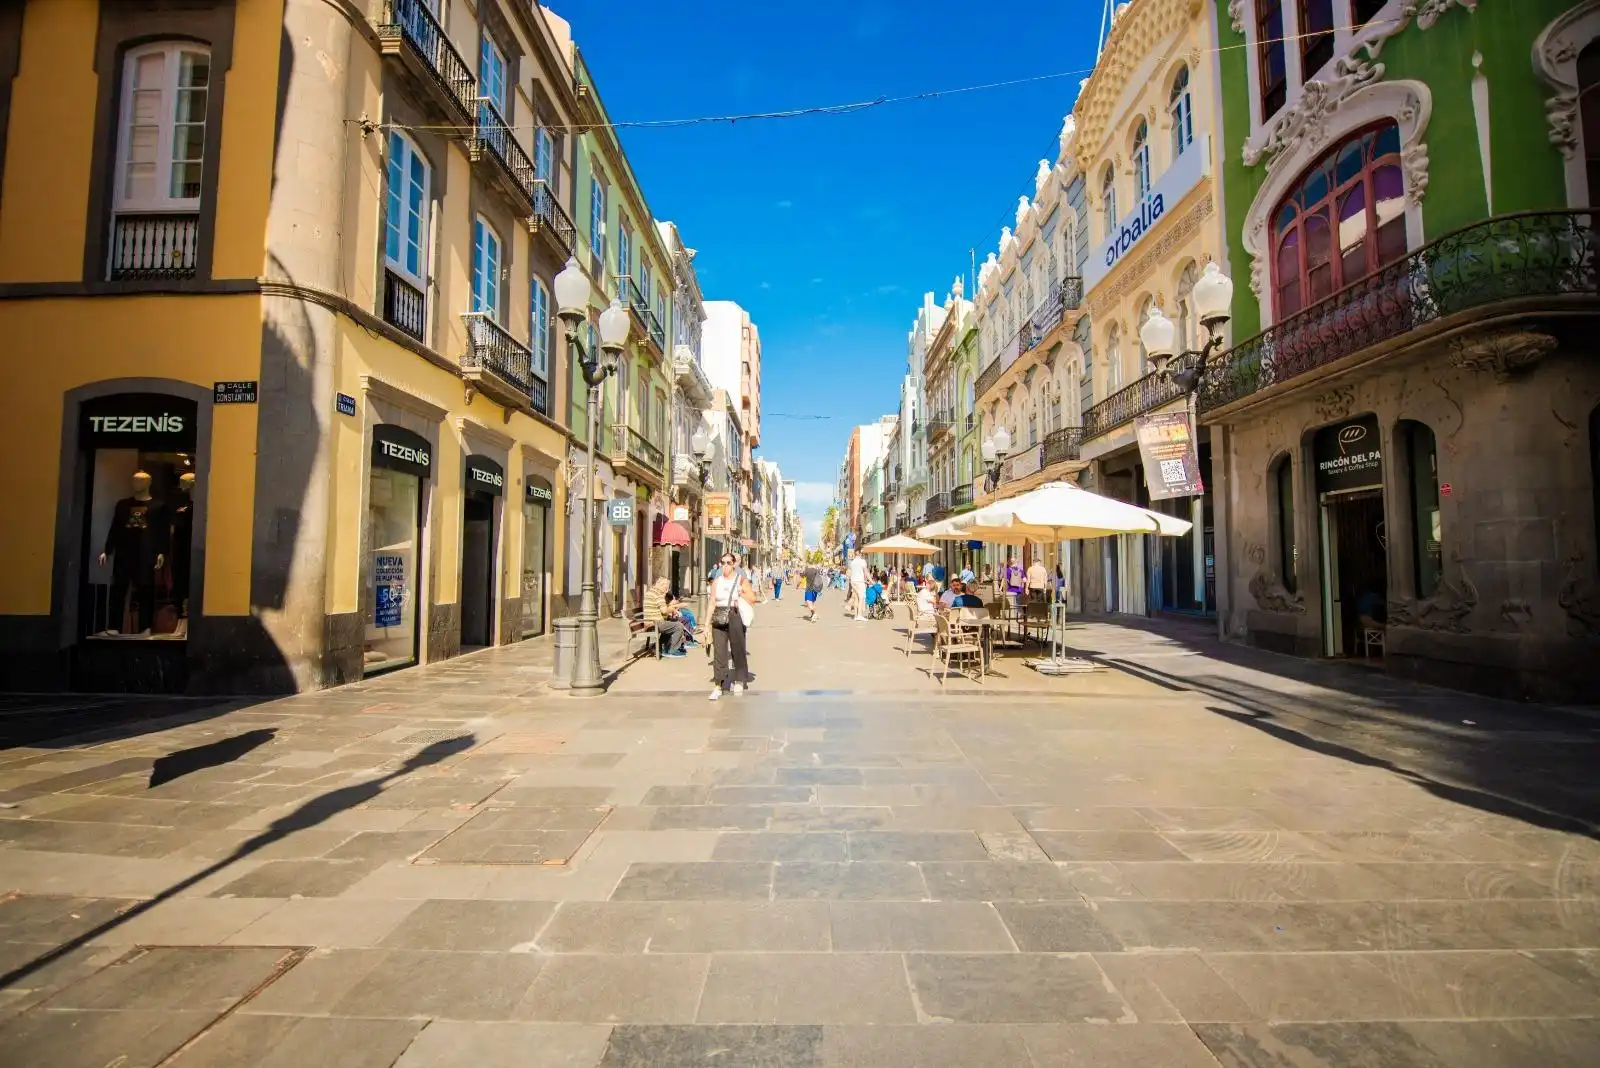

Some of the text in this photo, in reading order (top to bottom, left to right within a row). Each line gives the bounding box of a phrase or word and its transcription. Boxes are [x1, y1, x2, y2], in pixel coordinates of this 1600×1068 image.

[1105, 193, 1164, 266] orbalia
[216, 392, 255, 402] CONSTANTINO
[1320, 450, 1381, 470] RINCÓN DEL PA
[376, 556, 403, 566] NUEVA
